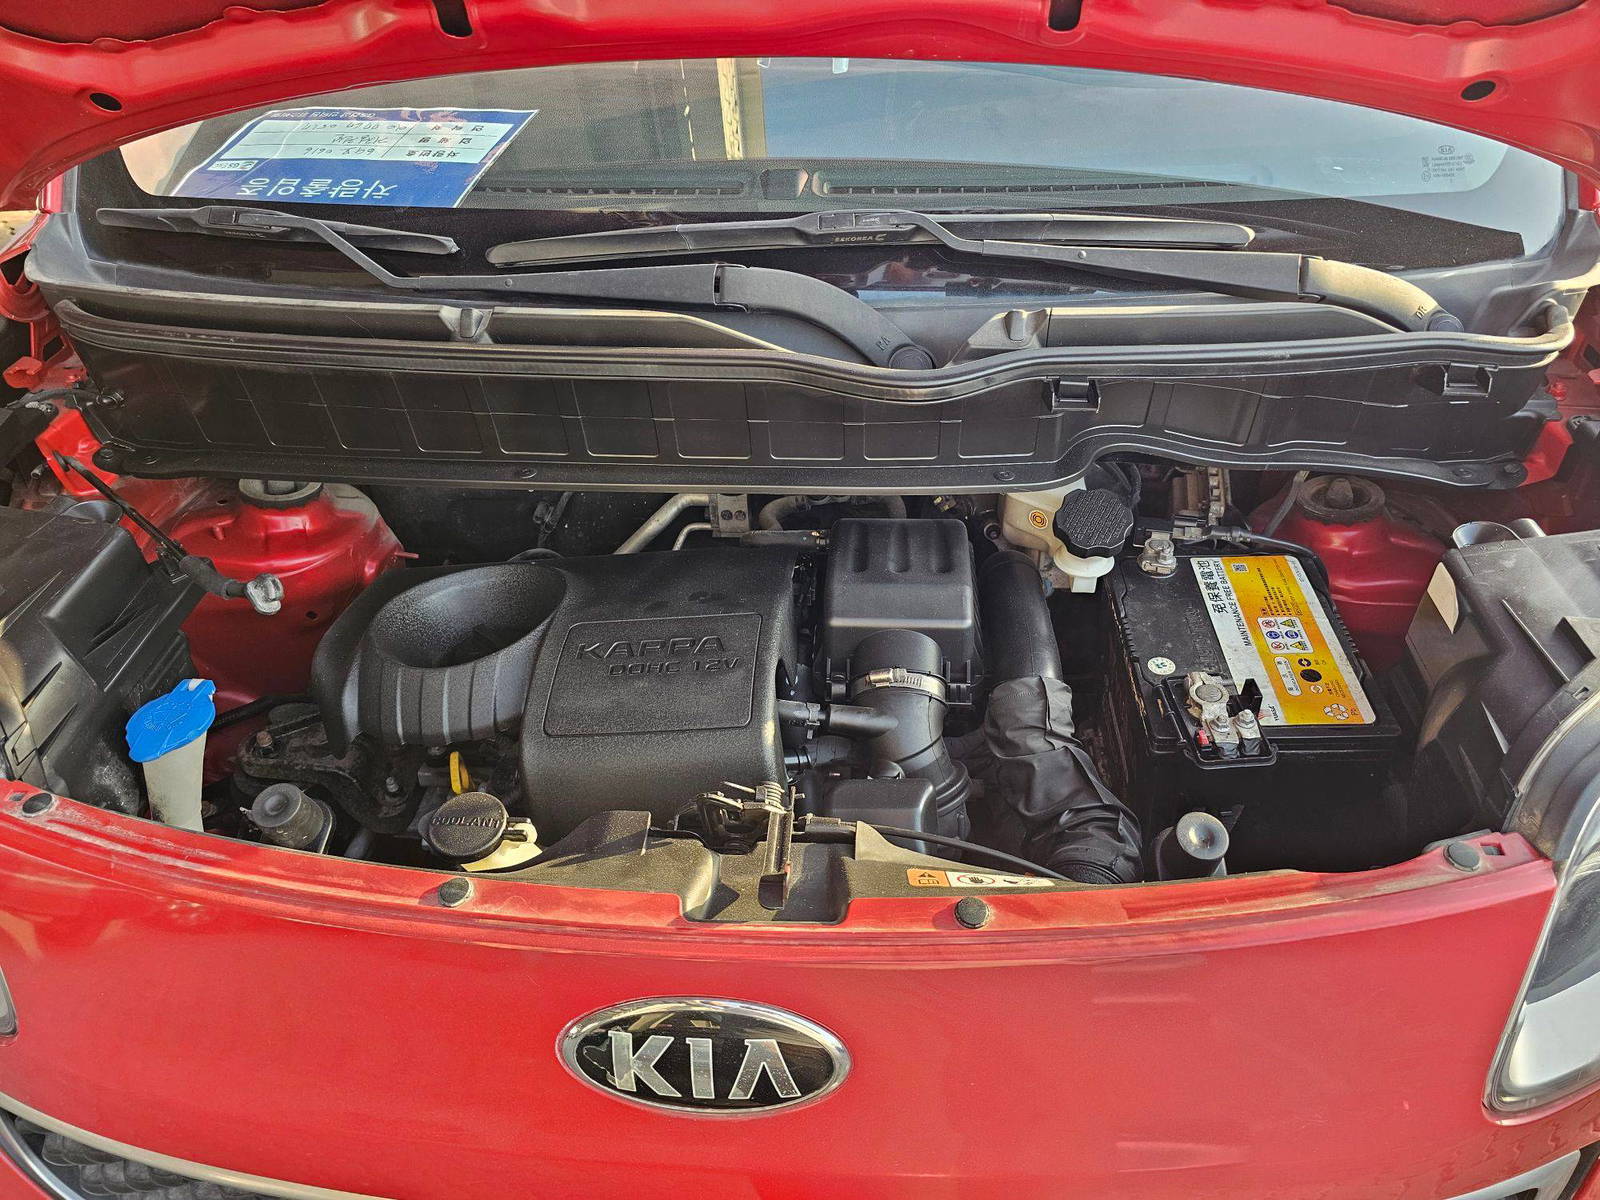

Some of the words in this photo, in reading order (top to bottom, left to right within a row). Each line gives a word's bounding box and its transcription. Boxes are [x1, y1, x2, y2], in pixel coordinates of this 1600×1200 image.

[405, 149, 462, 159] 차량번호
[236, 177, 398, 199] 차량출입증
[1213, 560, 1229, 585] BATTERY
[1222, 585, 1235, 601] FREE
[1228, 601, 1253, 647] MAINTENANCE
[575, 635, 726, 660] KAPPA
[608, 661, 681, 677] DOHC
[692, 656, 740, 672] 12V
[431, 815, 500, 829] COOLANT
[607, 1029, 803, 1101] KIA
